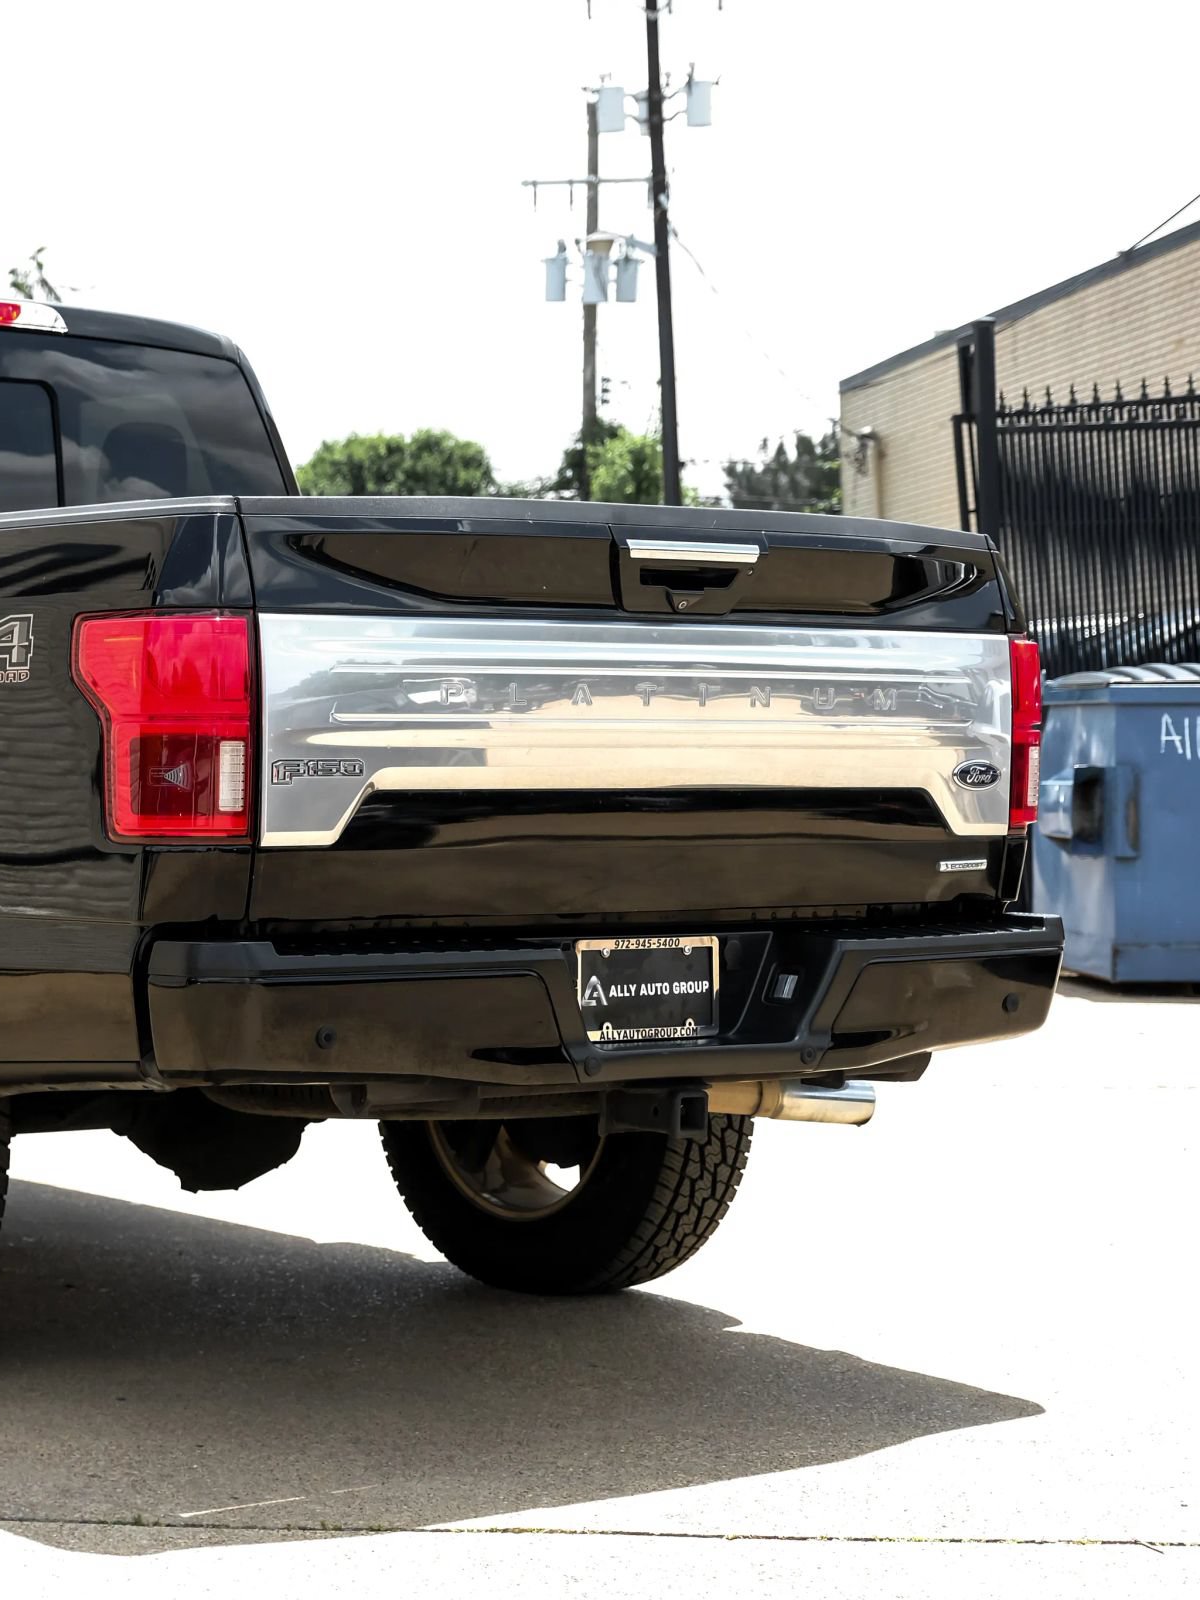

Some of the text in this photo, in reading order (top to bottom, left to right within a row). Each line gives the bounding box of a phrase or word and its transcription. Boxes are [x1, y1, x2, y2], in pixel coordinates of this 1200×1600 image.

[439, 681, 898, 711] PLATINUM
[966, 765, 993, 783] Ford
[614, 938, 680, 949] 972-945-5400
[609, 980, 709, 998] ALLY AUTO GROUP
[600, 1026, 698, 1041] ALLYAUTOGROUP.COM
